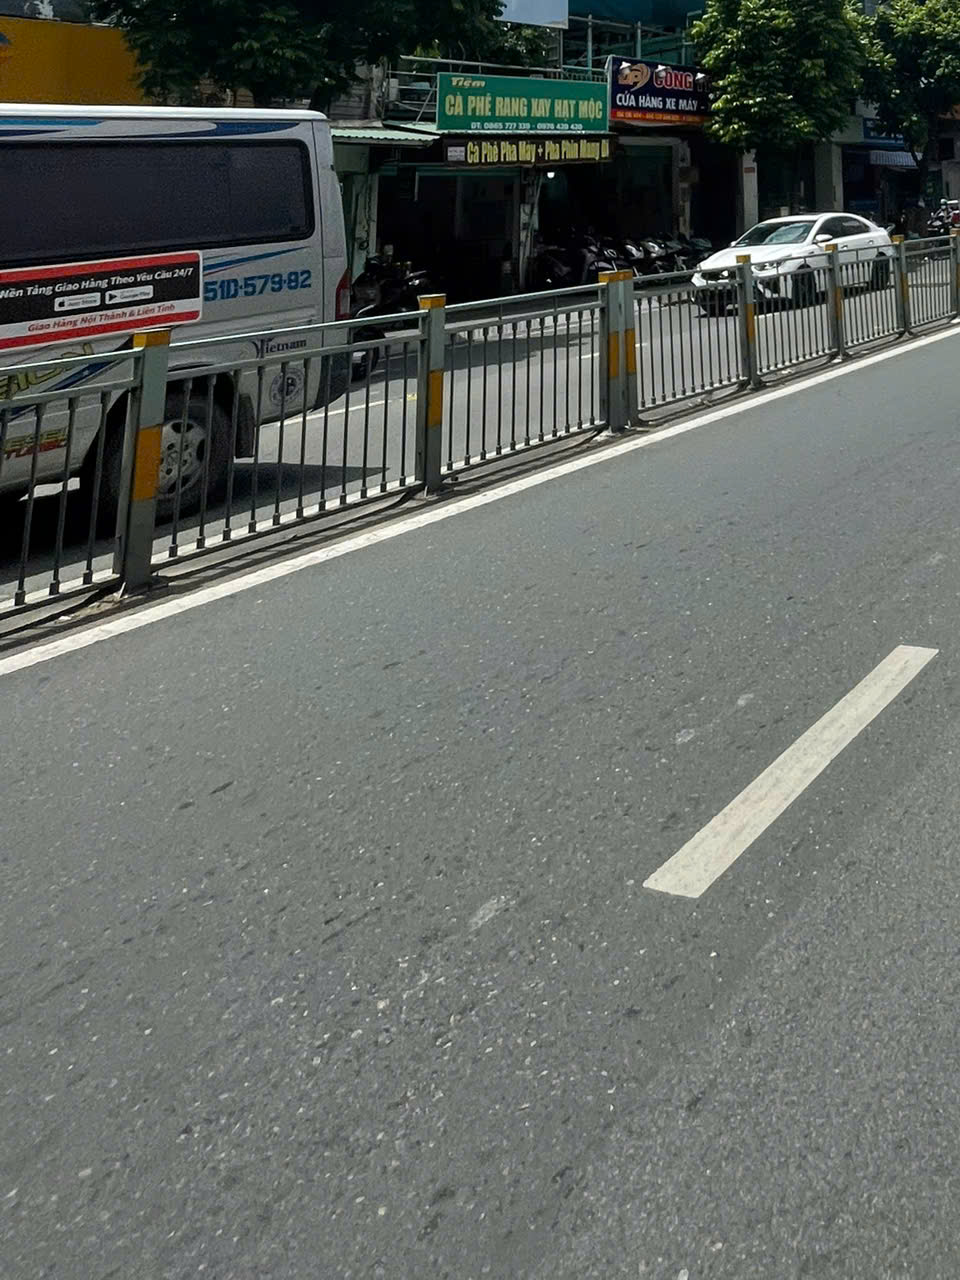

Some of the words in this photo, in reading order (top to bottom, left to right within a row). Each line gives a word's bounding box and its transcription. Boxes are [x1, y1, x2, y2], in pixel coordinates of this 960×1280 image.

[445, 92, 463, 116] CÀ
[495, 96, 527, 118] RANG
[531, 98, 551, 118] XAY
[665, 98, 676, 110] XE
[678, 97, 698, 111] MÁY
[55, 281, 79, 293] Giao
[111, 276, 135, 286] Theo
[173, 267, 194, 277] 24/7
